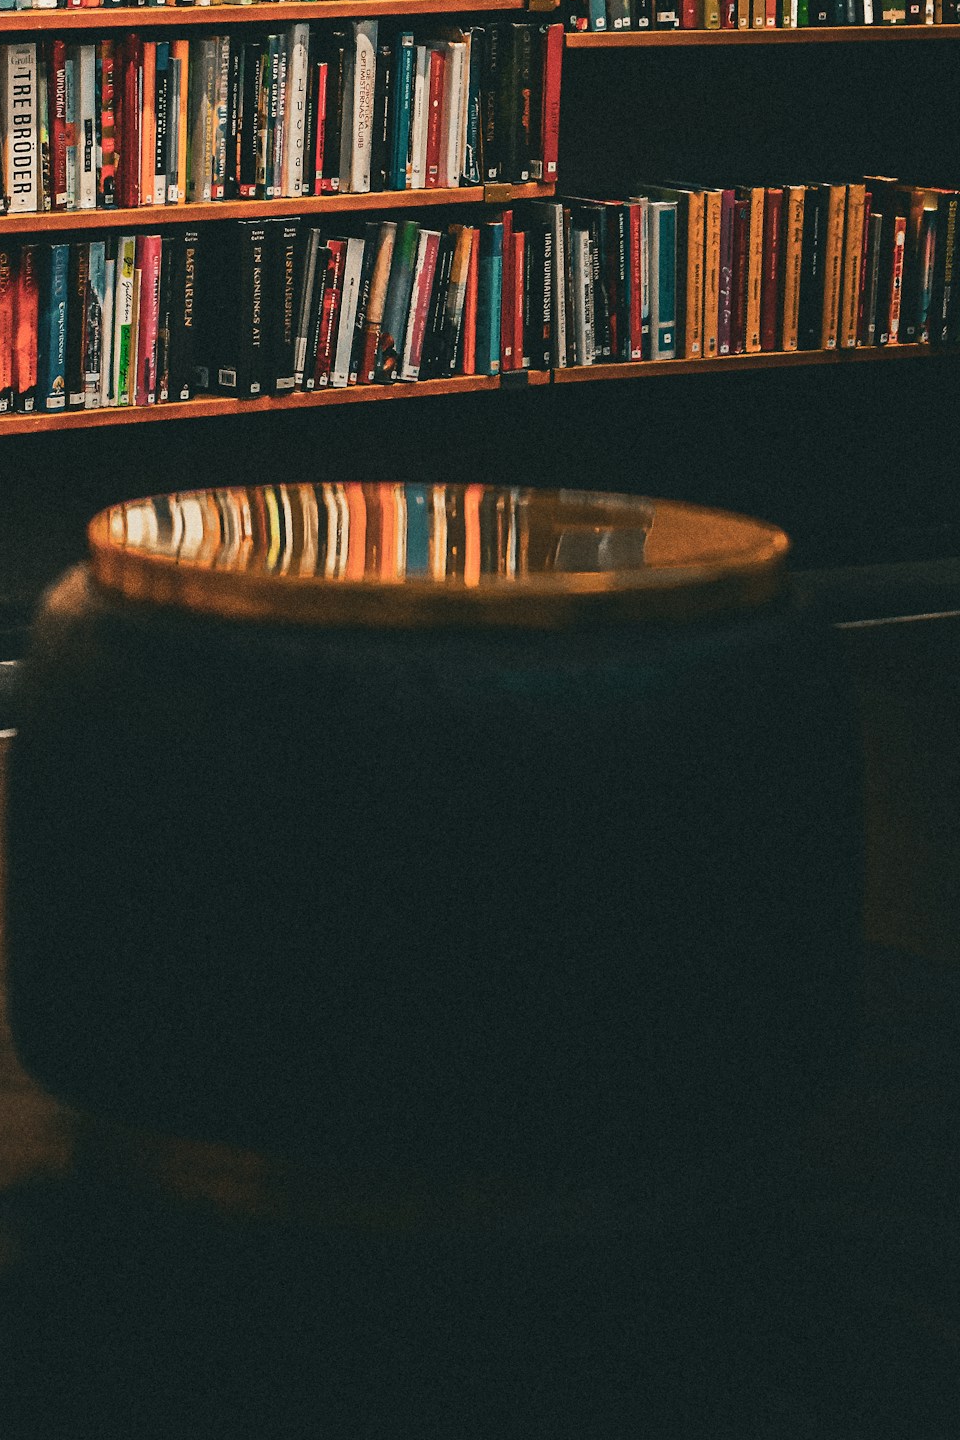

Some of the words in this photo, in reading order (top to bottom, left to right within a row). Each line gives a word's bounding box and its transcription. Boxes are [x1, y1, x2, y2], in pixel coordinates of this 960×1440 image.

[14, 70, 32, 107] TRE
[56, 69, 66, 118] Wunderkind
[359, 50, 367, 119] OPTIMISTERNAS
[13, 114, 35, 194] BRÖDER
[357, 121, 365, 148] KLUBB
[254, 247, 262, 262] EN
[544, 232, 552, 257] HANS
[184, 248, 195, 328] BASTARDEN
[253, 268, 262, 323] KONUNGS
[543, 260, 551, 321] GUNNARSSON
